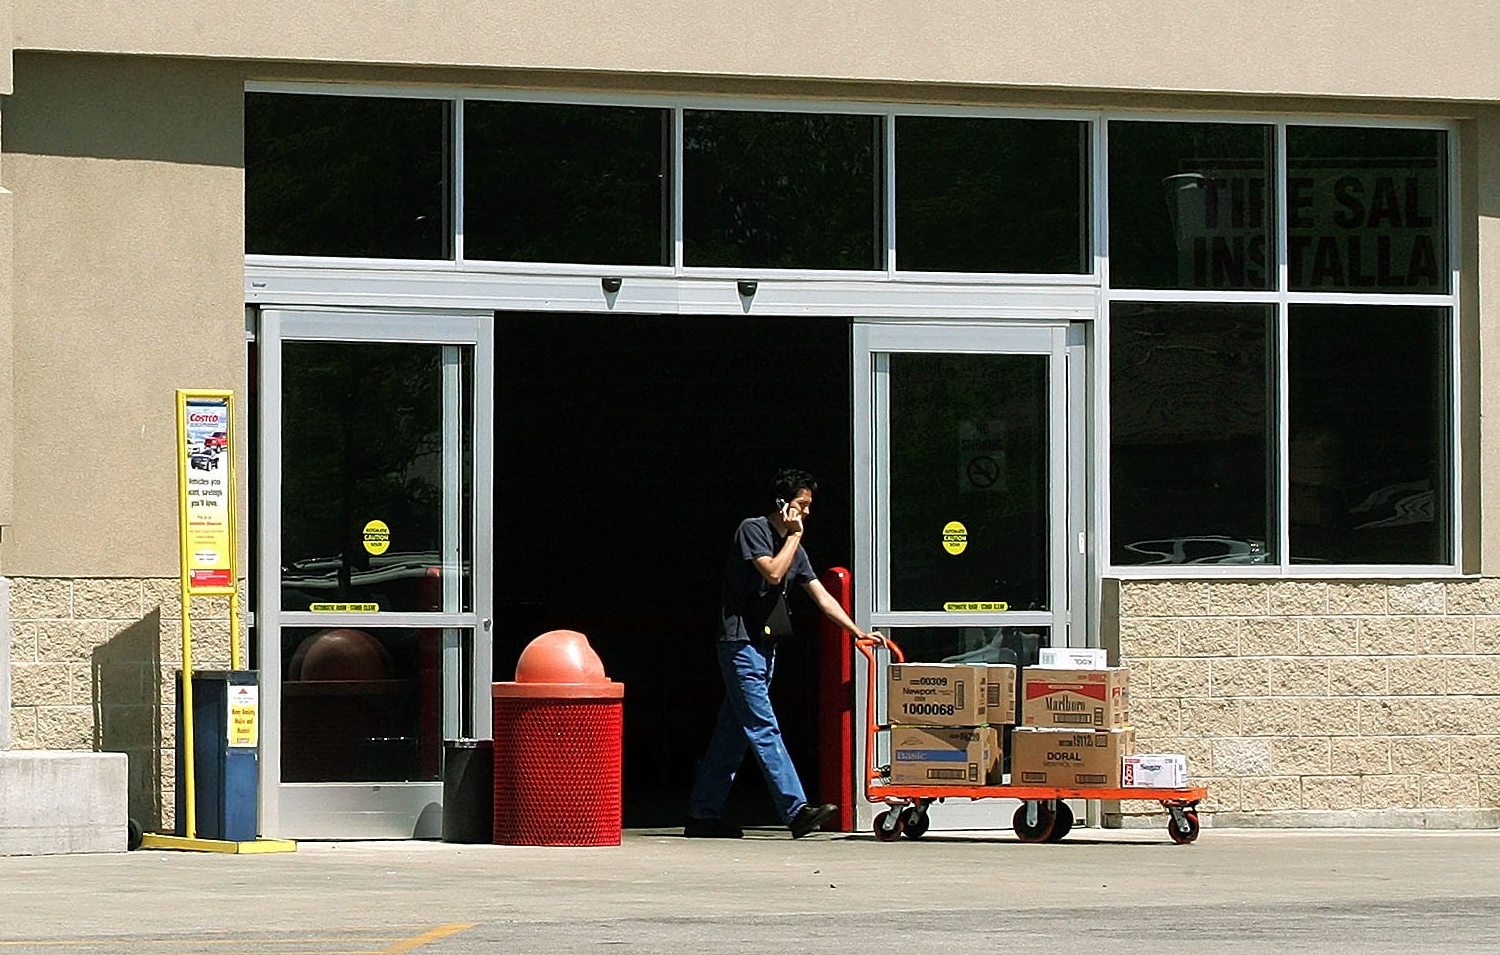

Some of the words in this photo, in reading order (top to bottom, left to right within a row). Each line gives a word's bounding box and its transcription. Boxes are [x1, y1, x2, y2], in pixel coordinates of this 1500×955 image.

[920, 677, 947, 686] 00309
[902, 687, 936, 696] Newport
[1045, 694, 1086, 711] Marlboro
[902, 703, 954, 715] 1000068
[897, 751, 926, 760] Basic
[1047, 752, 1082, 761] DORAL
